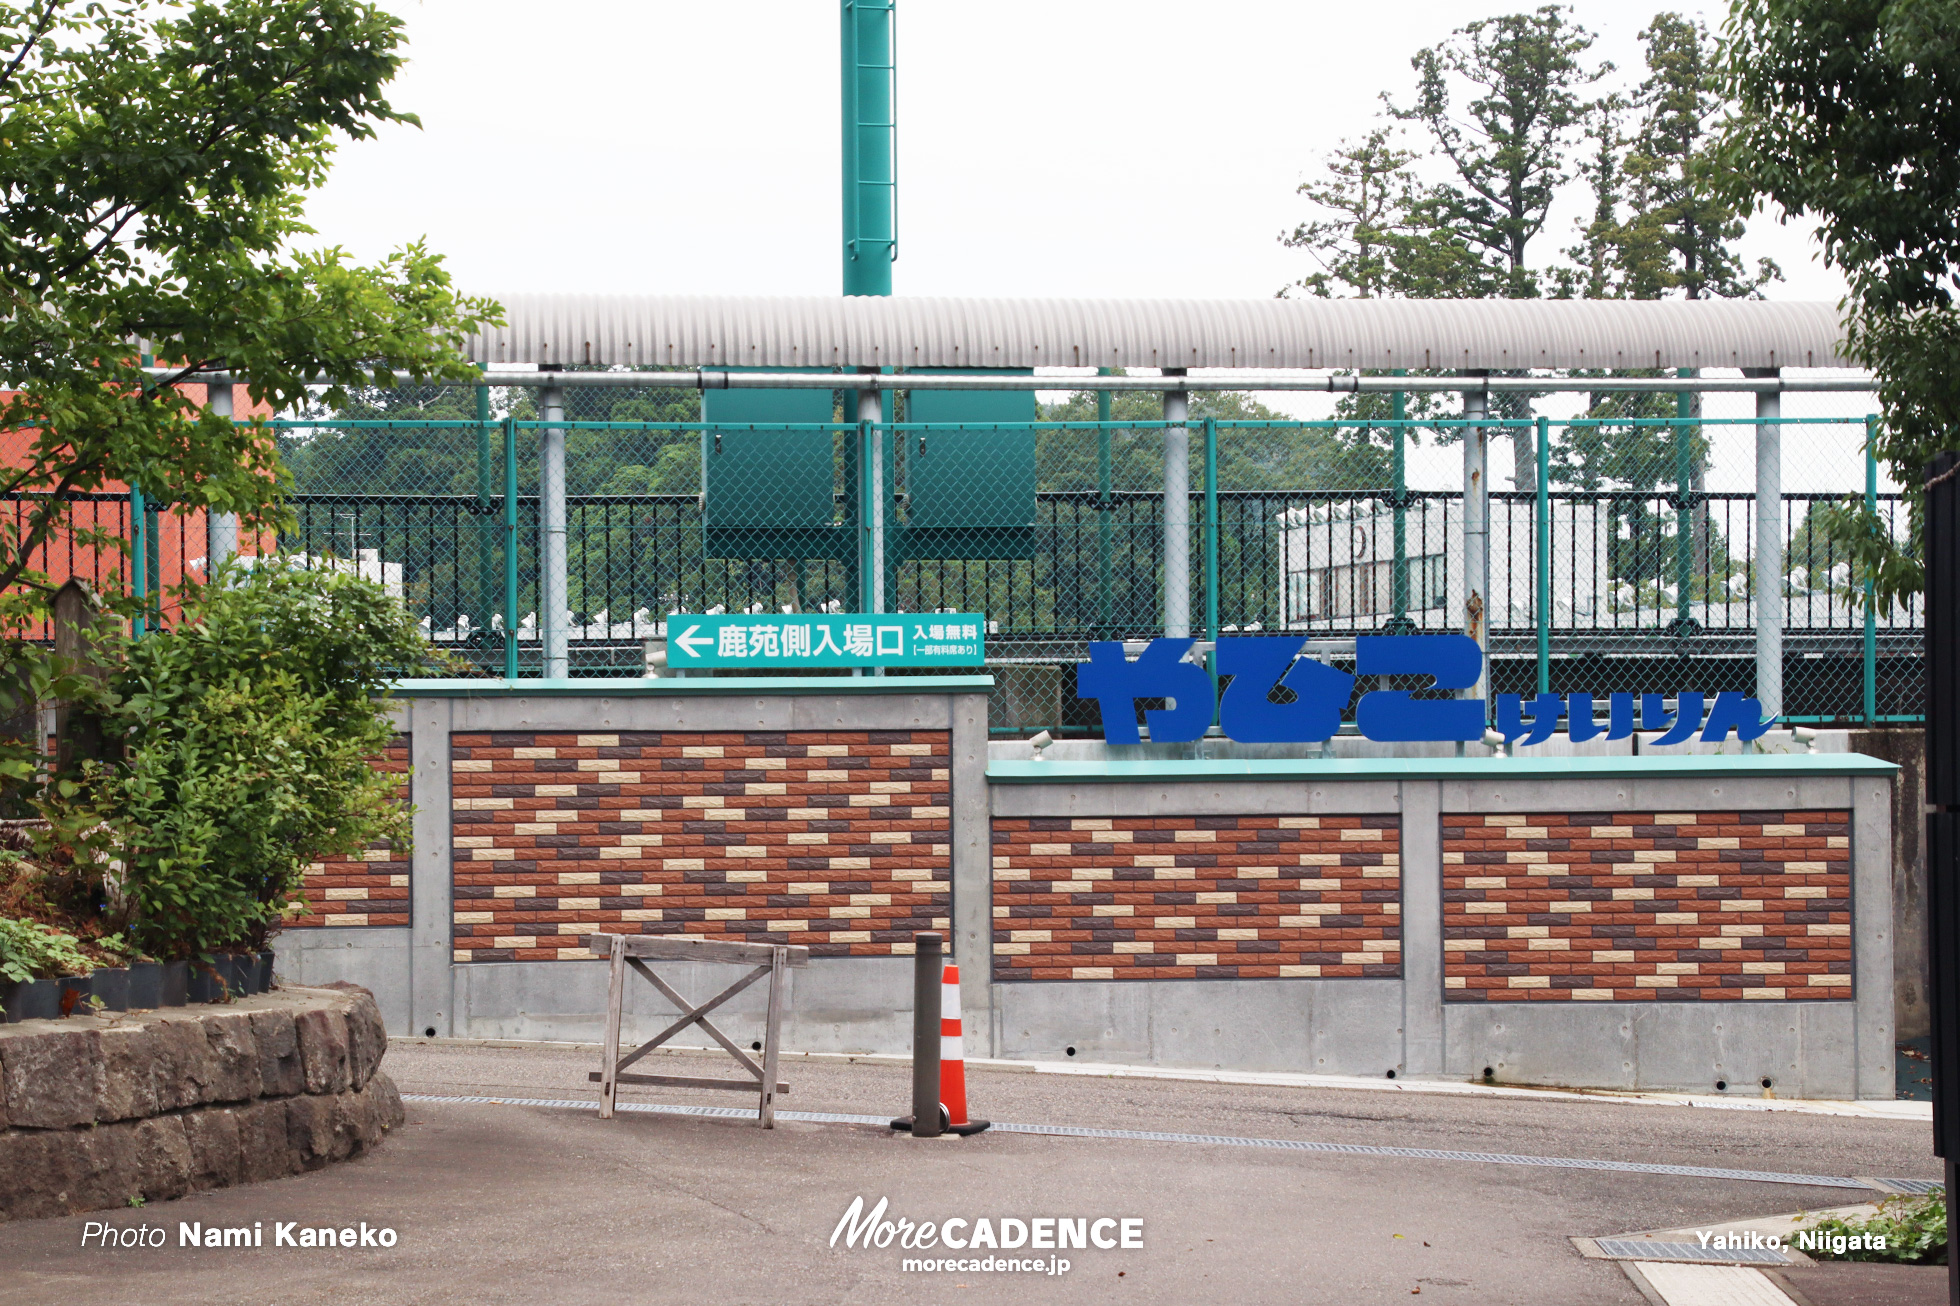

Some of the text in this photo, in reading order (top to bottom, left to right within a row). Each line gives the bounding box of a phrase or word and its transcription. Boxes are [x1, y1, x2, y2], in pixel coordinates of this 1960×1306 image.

[717, 623, 904, 658] 鹿苑側入場口
[912, 624, 978, 640] 入場無料
